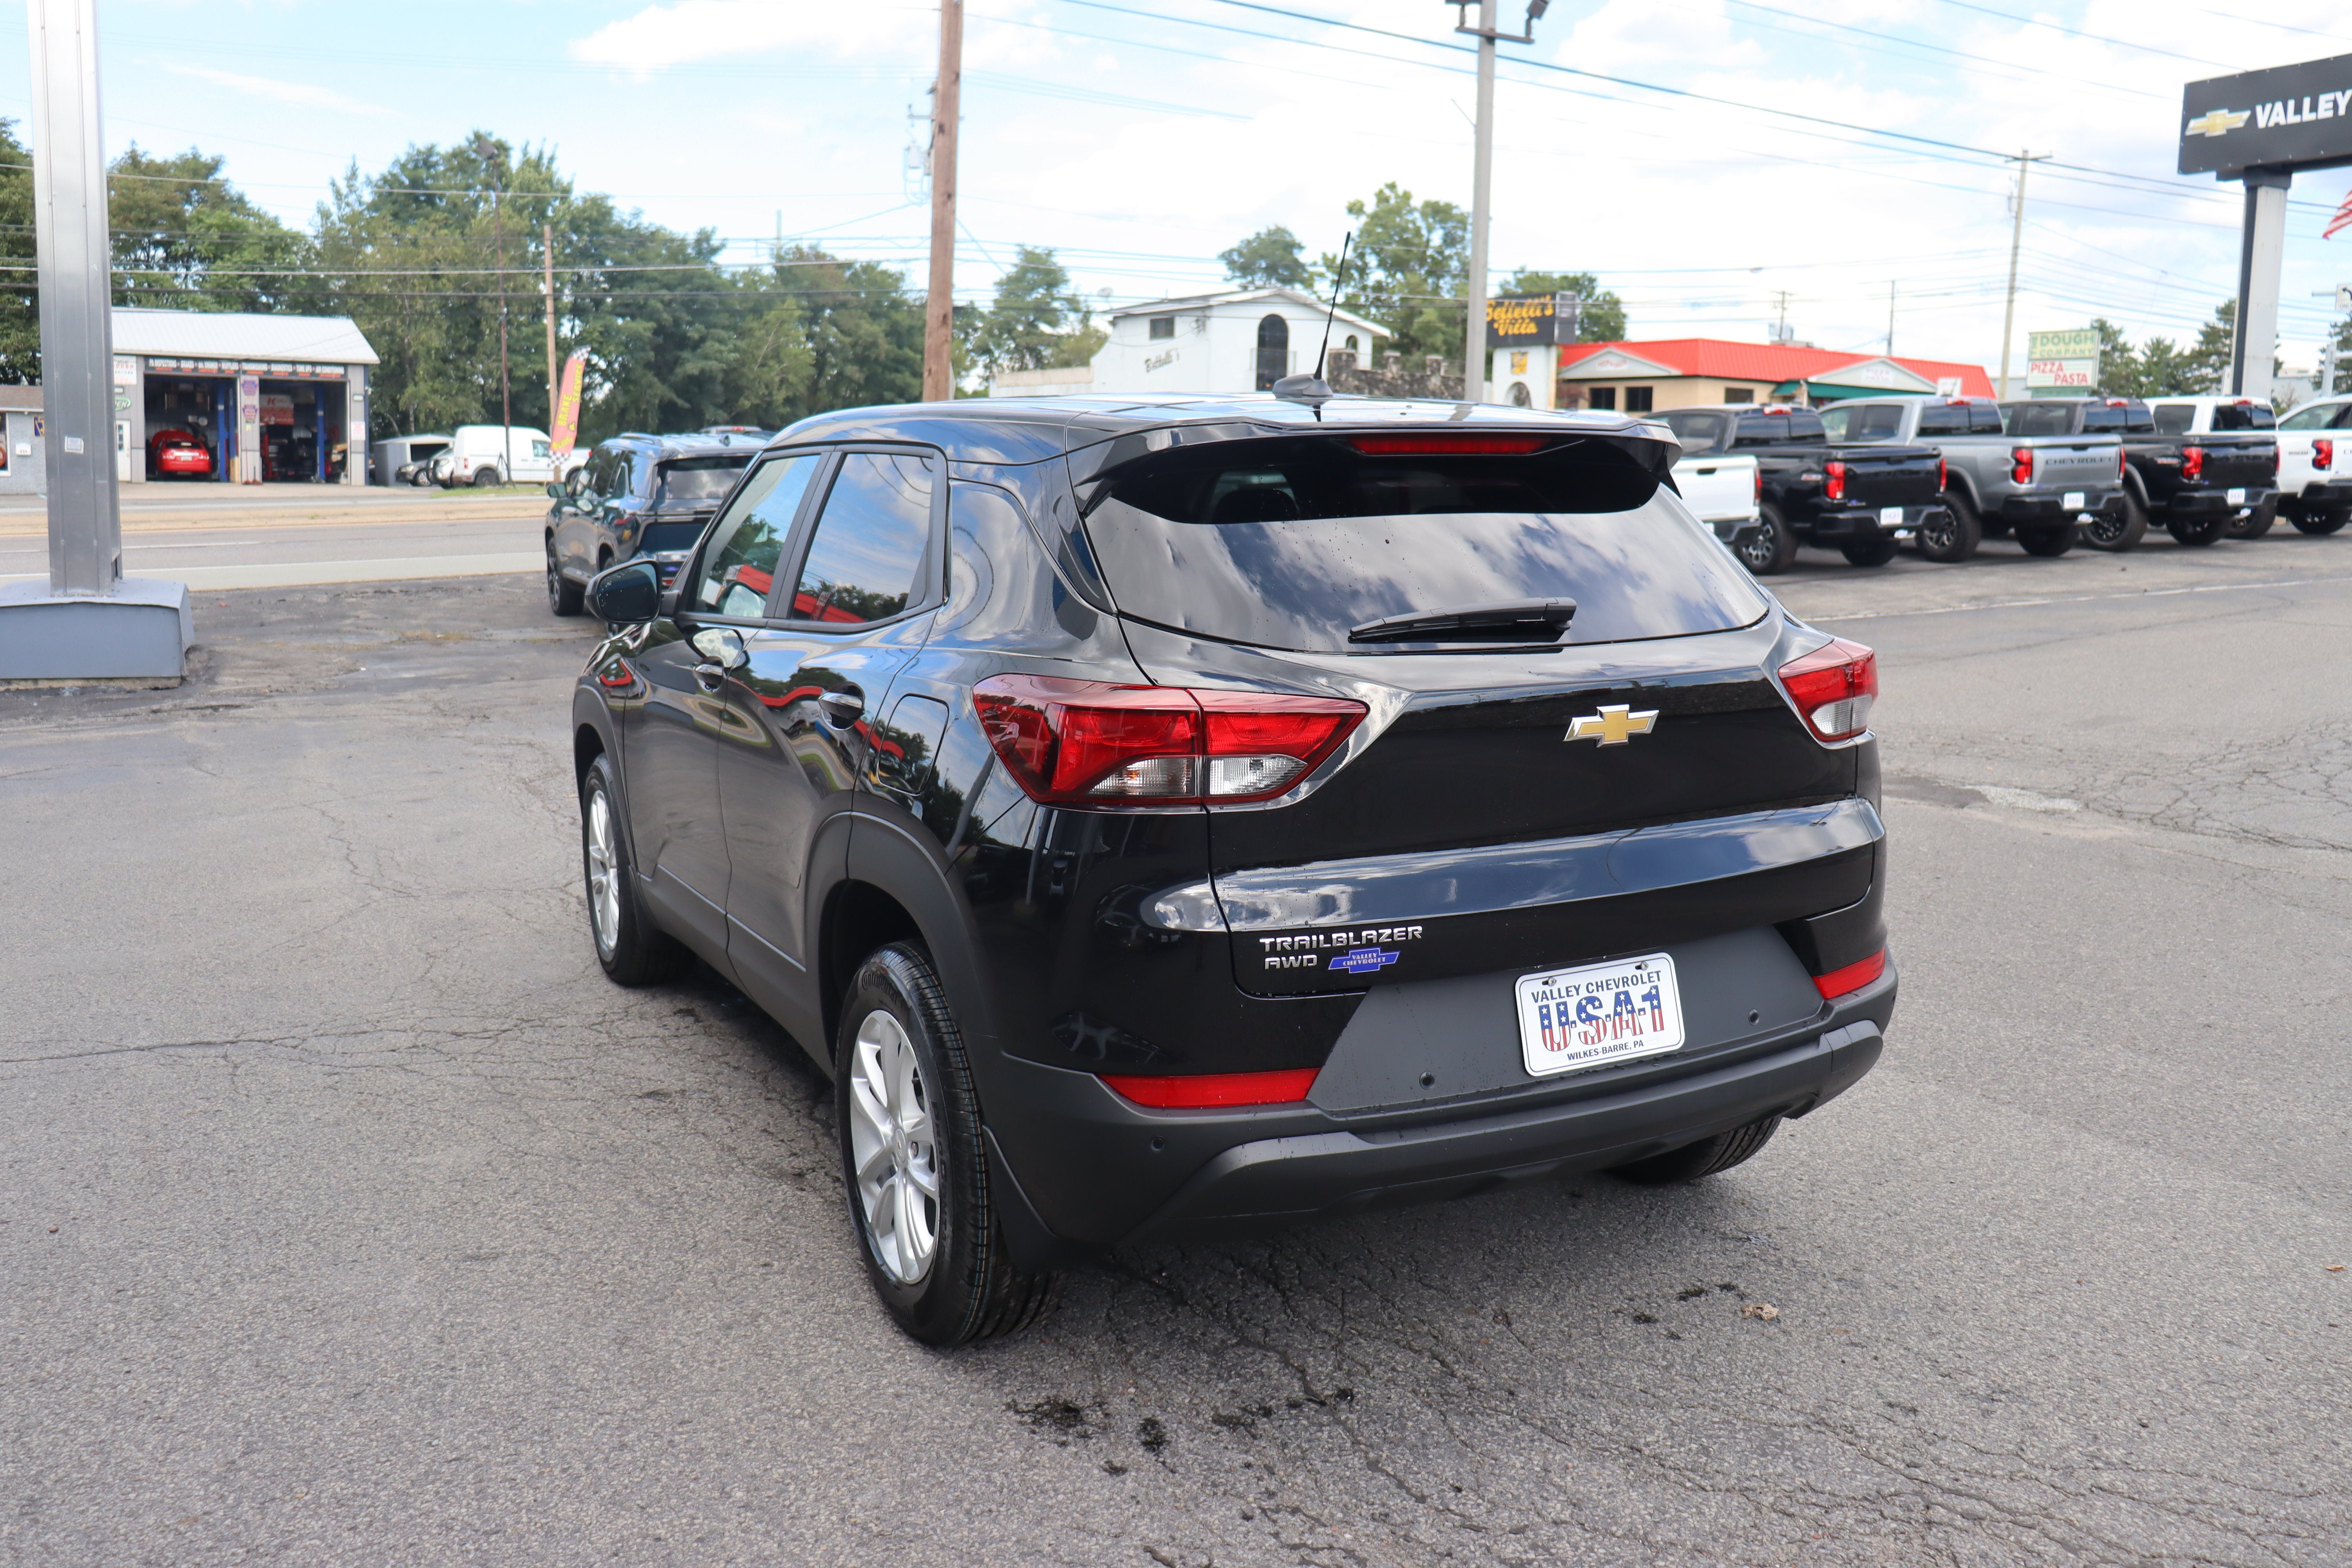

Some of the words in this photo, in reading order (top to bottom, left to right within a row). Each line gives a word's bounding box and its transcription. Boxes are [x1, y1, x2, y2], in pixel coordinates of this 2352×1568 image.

[2256, 89, 2352, 129] VALLEY
[1493, 318, 1539, 336] Villa
[2040, 334, 2094, 346] DOUGH
[2040, 348, 2092, 356] COMPANY
[2031, 361, 2064, 374] PIZZA
[572, 362, 583, 403] SERVICE
[2054, 372, 2088, 385] PASTA
[557, 394, 572, 426] BRAKE
[1259, 925, 1423, 952] TRAILBLAZER
[1265, 954, 1318, 970] AWD
[1342, 956, 1386, 967] CHEVROLET
[1531, 984, 1581, 1003] VALLEY
[1586, 970, 1662, 994] CHEVROLET
[1567, 1042, 1632, 1061] WILKES-BARRE,
[1633, 1040, 1644, 1049] PA
